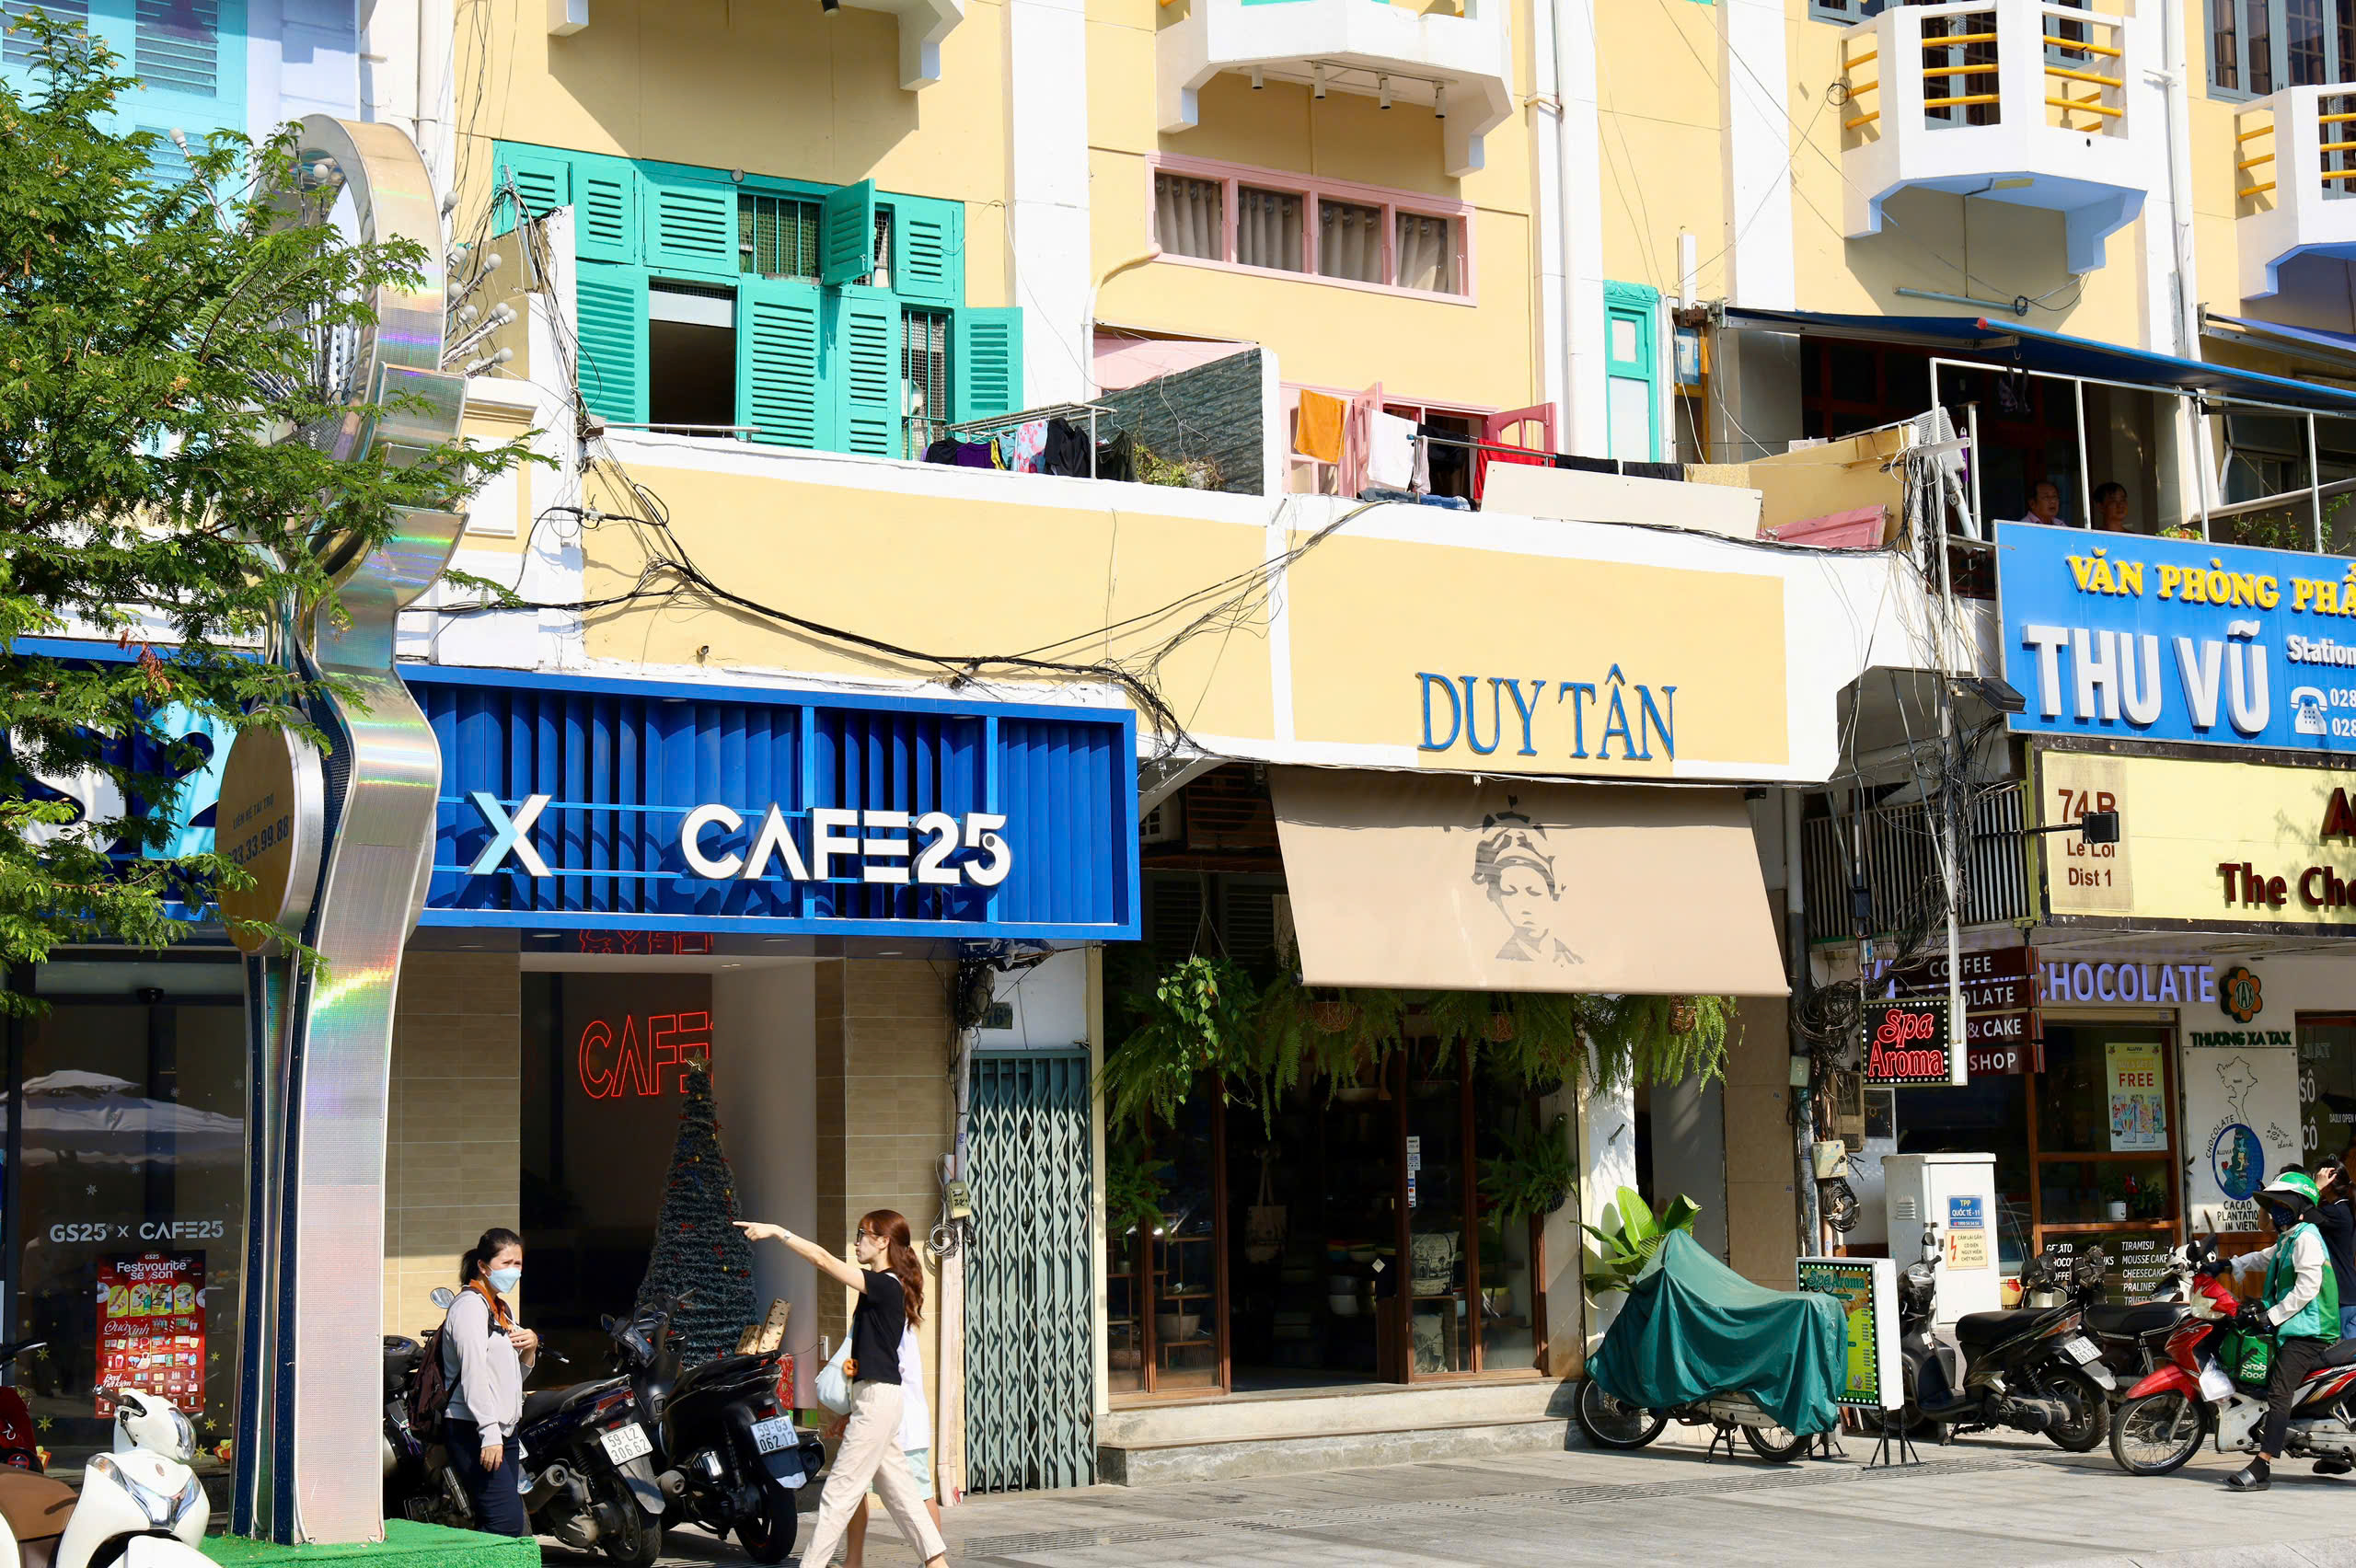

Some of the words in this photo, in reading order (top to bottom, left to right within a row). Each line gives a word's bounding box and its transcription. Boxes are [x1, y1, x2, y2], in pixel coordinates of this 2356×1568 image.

[2066, 547, 2144, 596] VĂN
[2156, 558, 2281, 609] PHÒNG
[2023, 624, 2163, 725] THU
[2173, 620, 2271, 733] VŨ
[1415, 671, 1547, 757] DUY
[1558, 663, 1678, 762] TÂN
[2319, 788, 2356, 838] A
[464, 791, 552, 877] X
[678, 801, 1013, 887] CAFE25
[2067, 837, 2085, 857] Le
[2068, 867, 2100, 886] Dist
[2105, 870, 2112, 886] 1
[2217, 861, 2288, 906] The
[1929, 955, 1992, 978] COFEE
[1877, 1009, 1934, 1048] Spa
[1983, 1018, 2022, 1038] CAKE
[1868, 1041, 1945, 1078] Aroma
[1969, 1052, 2017, 1071] SHOP
[2119, 1072, 2154, 1087] FREE
[2205, 1114, 2235, 1159] CHOCOLATE
[2223, 1200, 2253, 1211] CACAO
[2217, 1211, 2259, 1222] PLANTATIO
[2225, 1222, 2234, 1231] IN
[2236, 1221, 2259, 1231] VIETN
[50, 1223, 108, 1243] GS25
[139, 1220, 225, 1240] CAFE25
[2121, 1240, 2154, 1251] TIRAMISU
[2122, 1254, 2150, 1265] MOUSSE
[1806, 1271, 1832, 1290] Spa
[1832, 1273, 1865, 1289] Aroma
[2122, 1282, 2157, 1292] PRALINES
[607, 1427, 639, 1447] 59-L2
[756, 1418, 789, 1437] 59-G3
[759, 1431, 797, 1452] 062.12
